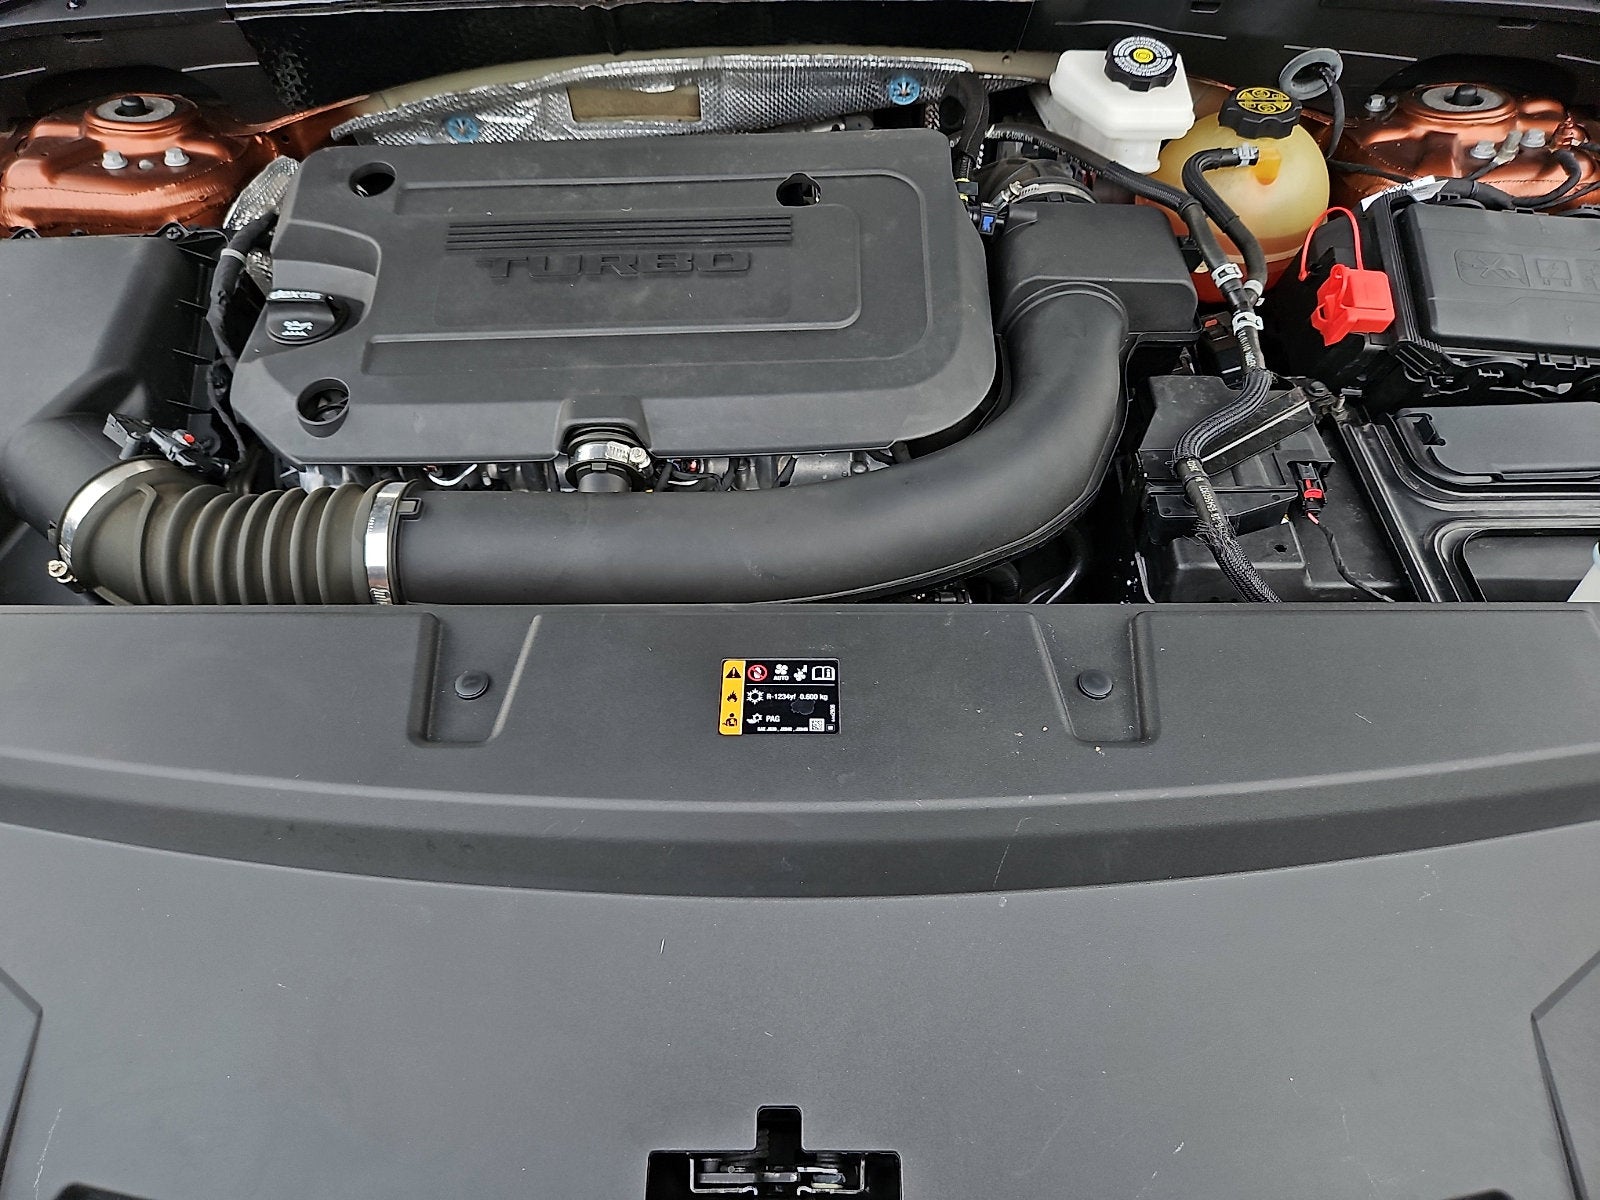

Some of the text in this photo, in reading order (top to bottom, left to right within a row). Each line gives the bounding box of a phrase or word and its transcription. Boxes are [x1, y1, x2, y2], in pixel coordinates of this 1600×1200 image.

[475, 254, 752, 279] TURBO
[766, 693, 796, 701] R-1234yf
[819, 693, 829, 702] kg
[765, 714, 781, 723] PAG
